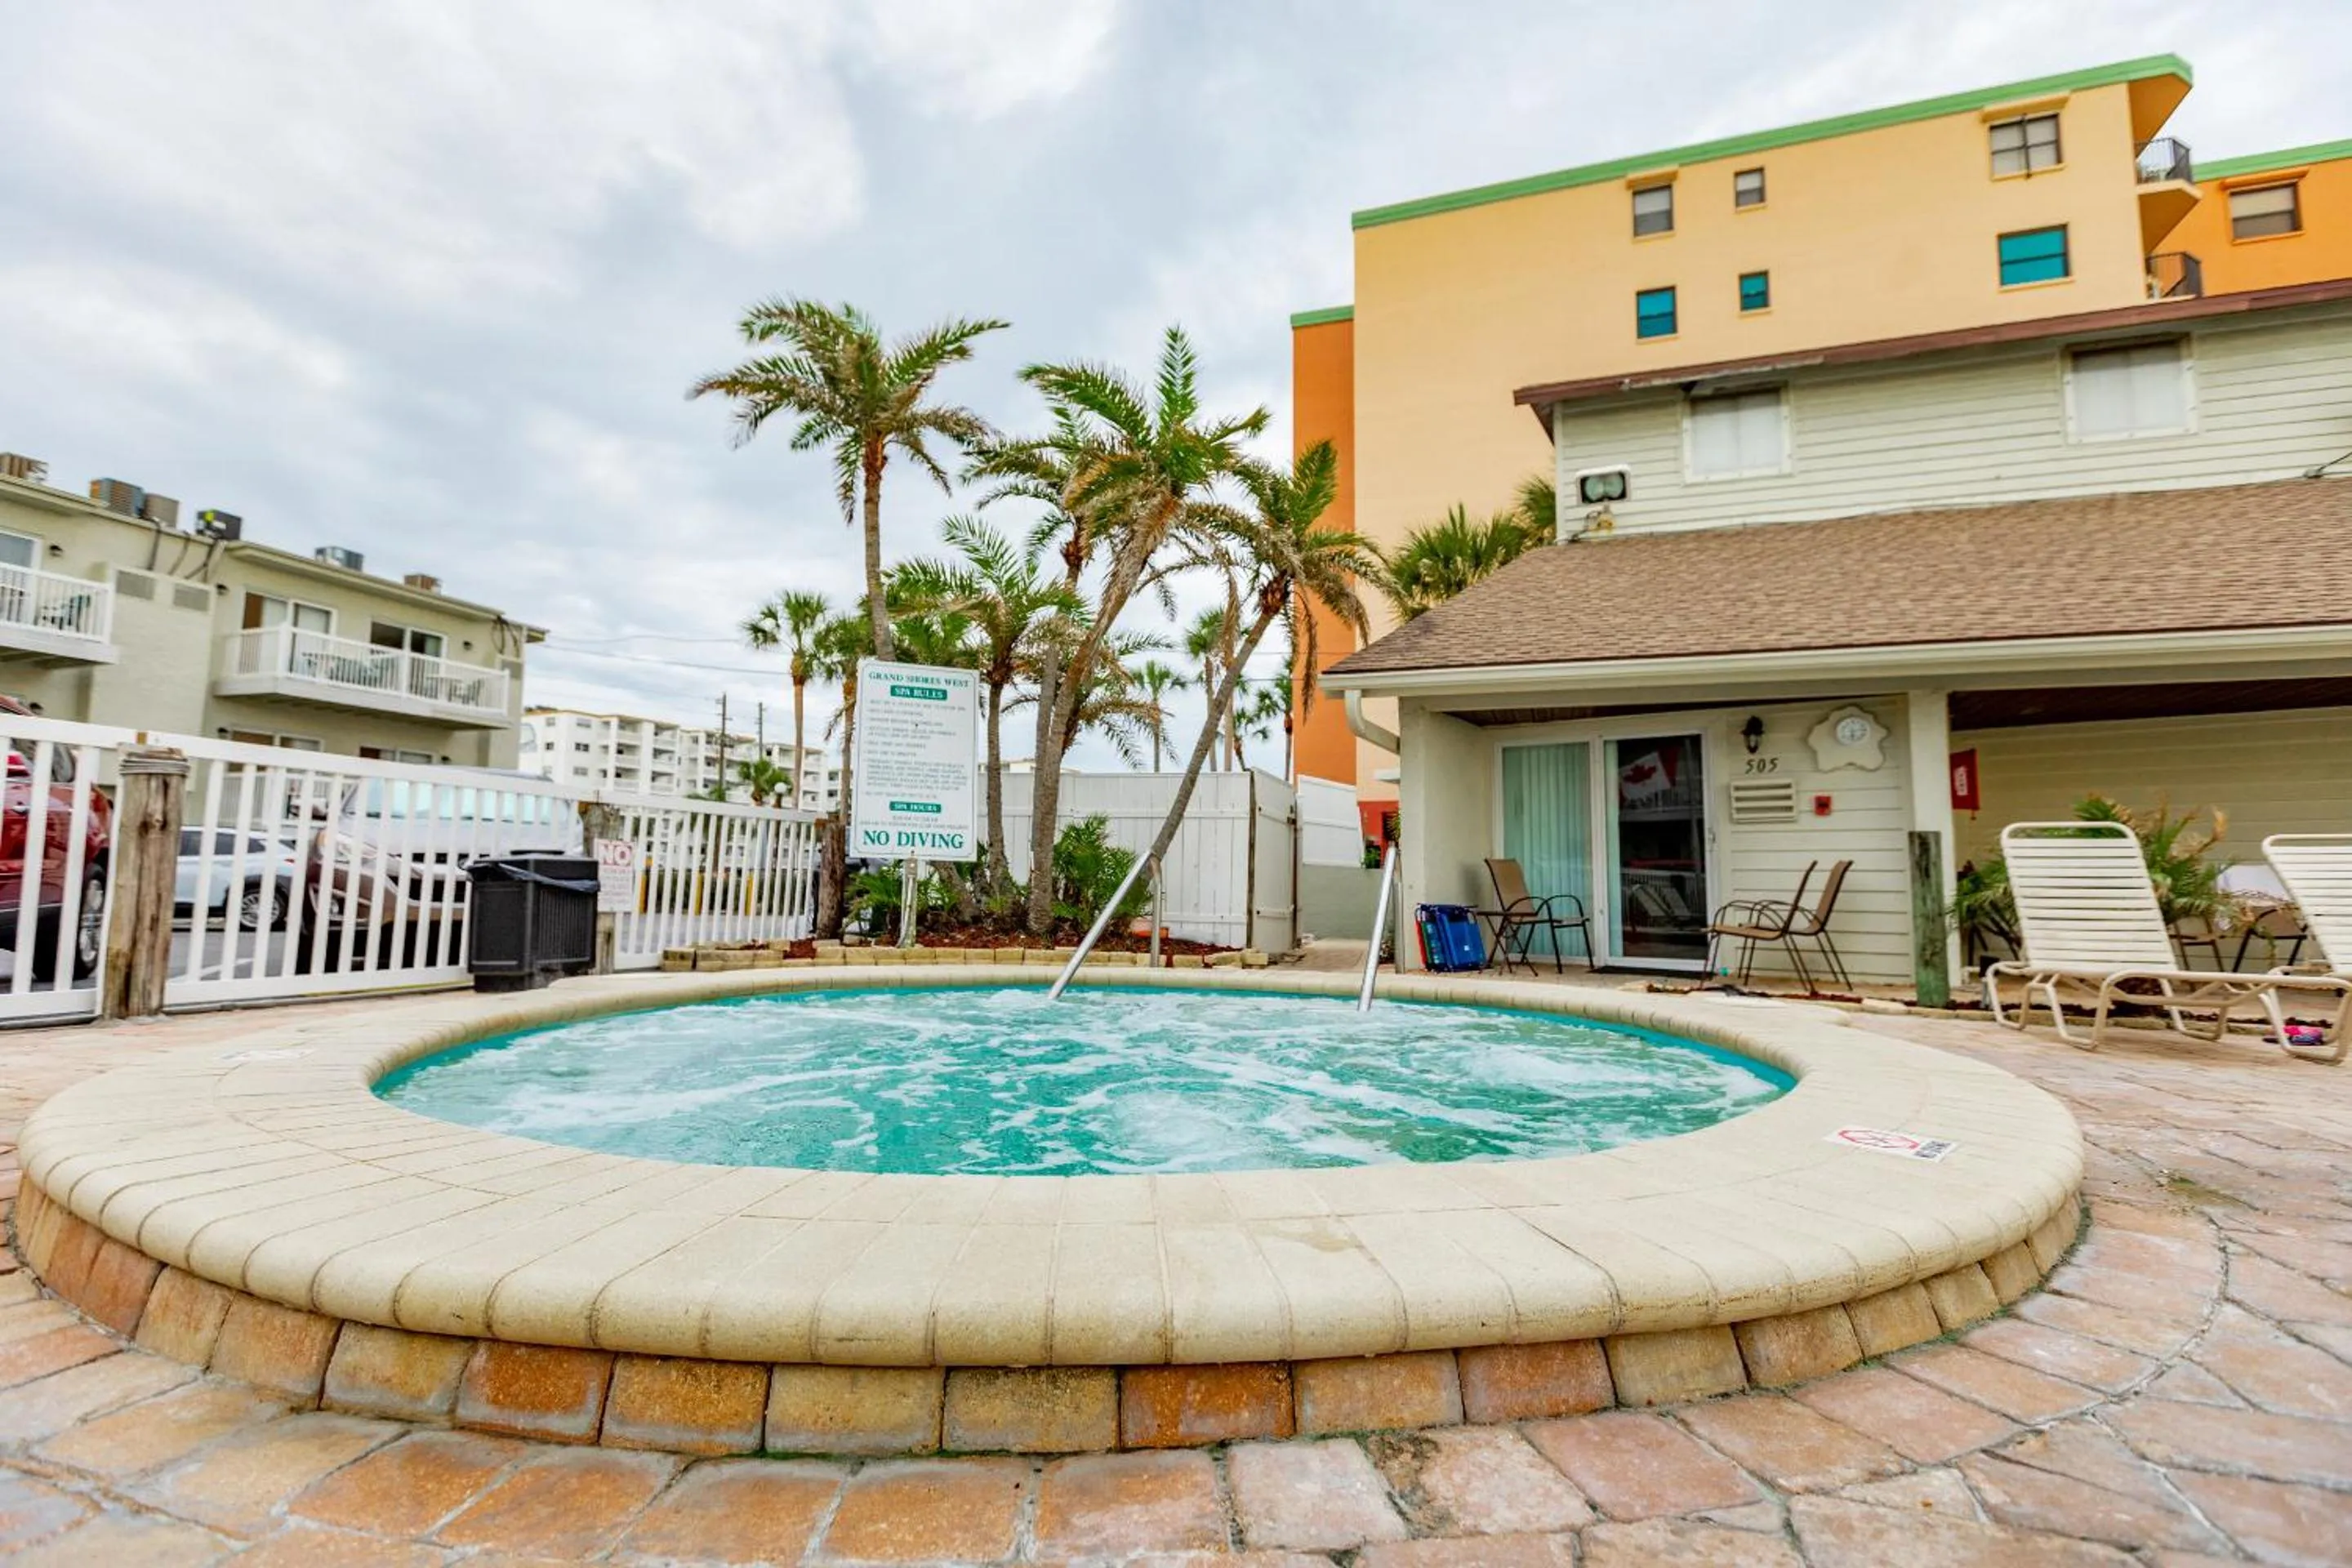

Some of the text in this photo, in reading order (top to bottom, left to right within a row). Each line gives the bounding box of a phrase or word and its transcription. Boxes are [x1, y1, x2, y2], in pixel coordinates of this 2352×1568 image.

[869, 671, 904, 682] GRAND
[944, 678, 969, 688] WEST
[894, 687, 943, 699] SPA RULES
[1745, 758, 1779, 775] 505
[863, 830, 964, 849] NO DIVING
